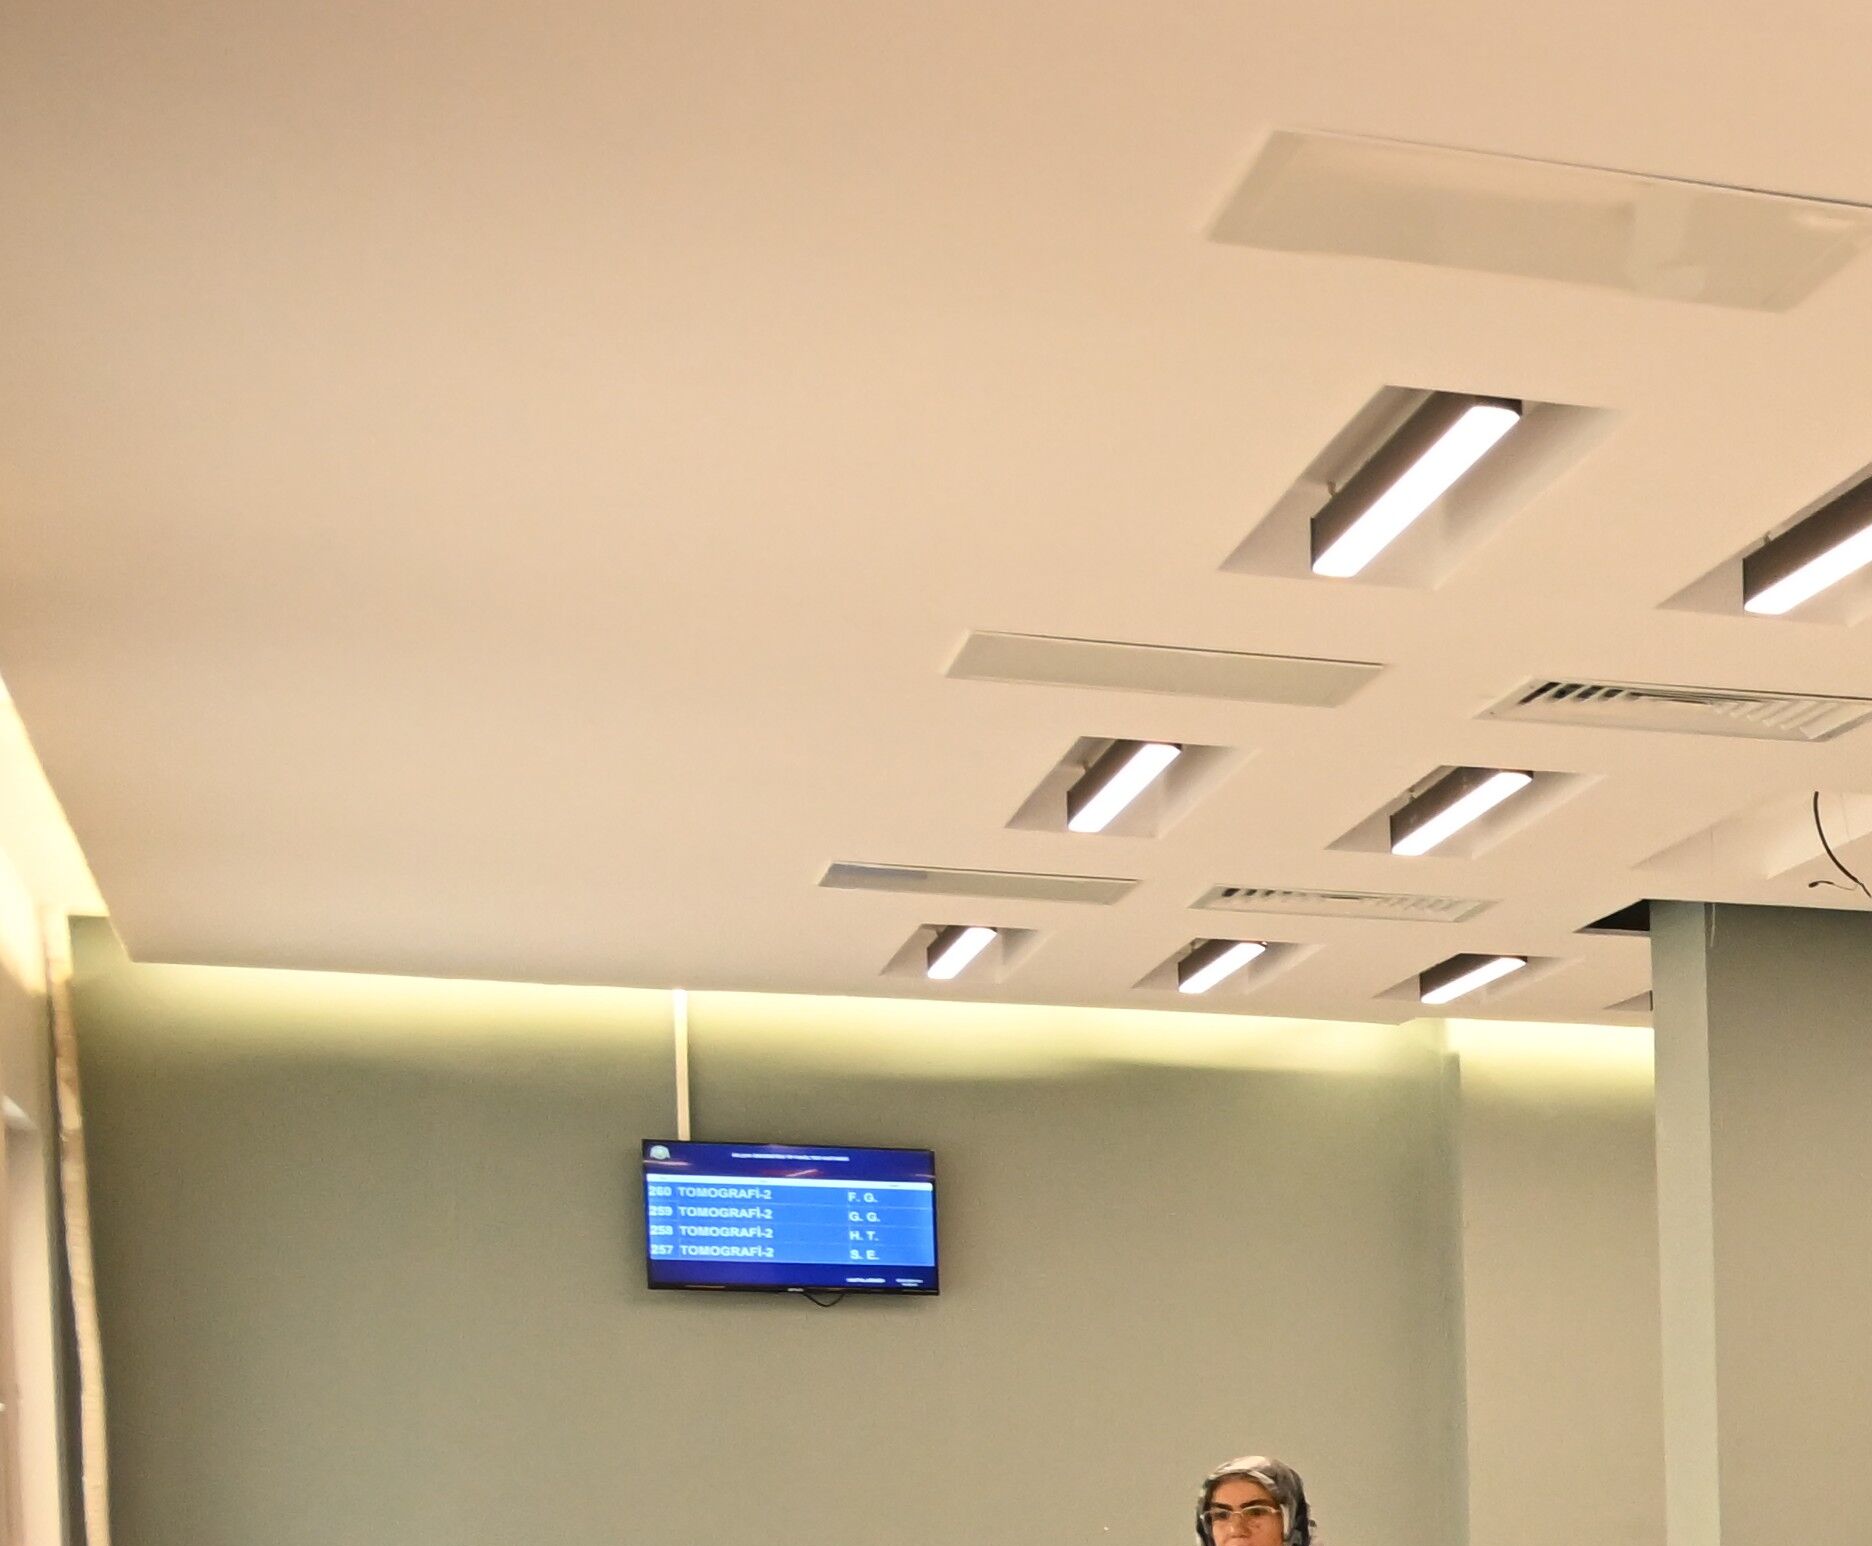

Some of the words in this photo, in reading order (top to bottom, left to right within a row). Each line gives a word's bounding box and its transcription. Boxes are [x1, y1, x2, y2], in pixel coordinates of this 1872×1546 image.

[678, 1186, 773, 1200] TOMOGRAFİ-2
[678, 1206, 773, 1219] TOMOGRAFİ-2
[679, 1225, 774, 1238] TOMOGRAFİ-2
[679, 1245, 775, 1258] TOMOGRAFİ-2
